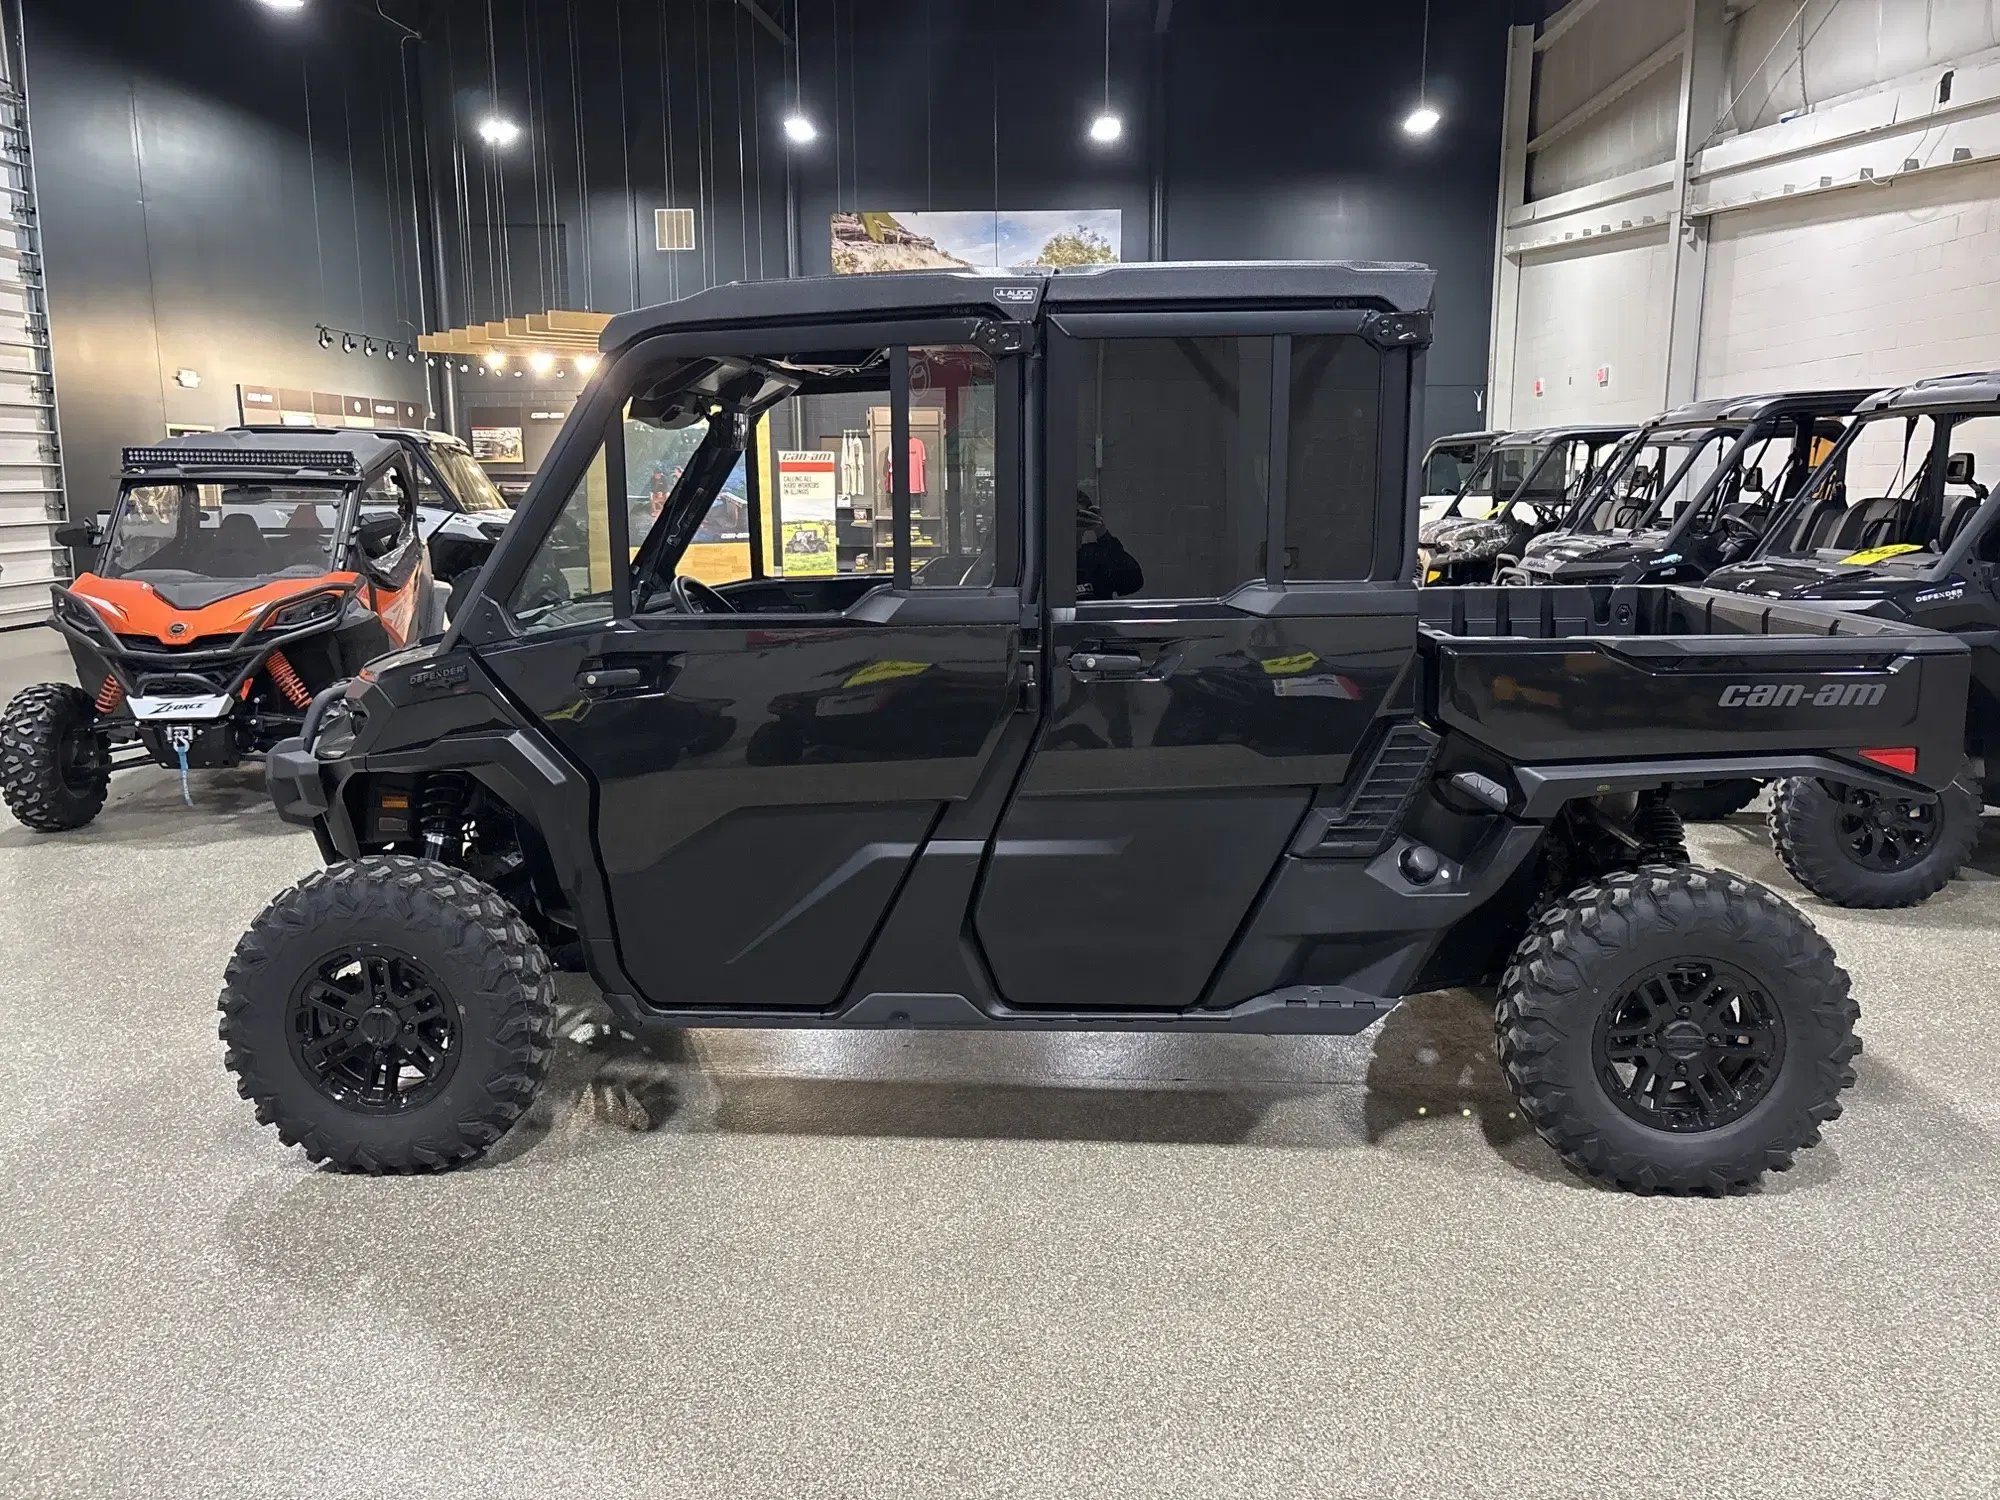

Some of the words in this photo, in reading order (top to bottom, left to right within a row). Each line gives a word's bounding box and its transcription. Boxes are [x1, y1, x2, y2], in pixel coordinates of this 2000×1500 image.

[782, 453, 831, 461] can-am
[1915, 588, 1963, 602] DEFENDER
[409, 665, 464, 684] DEFENDER
[1718, 684, 1887, 707] can-am
